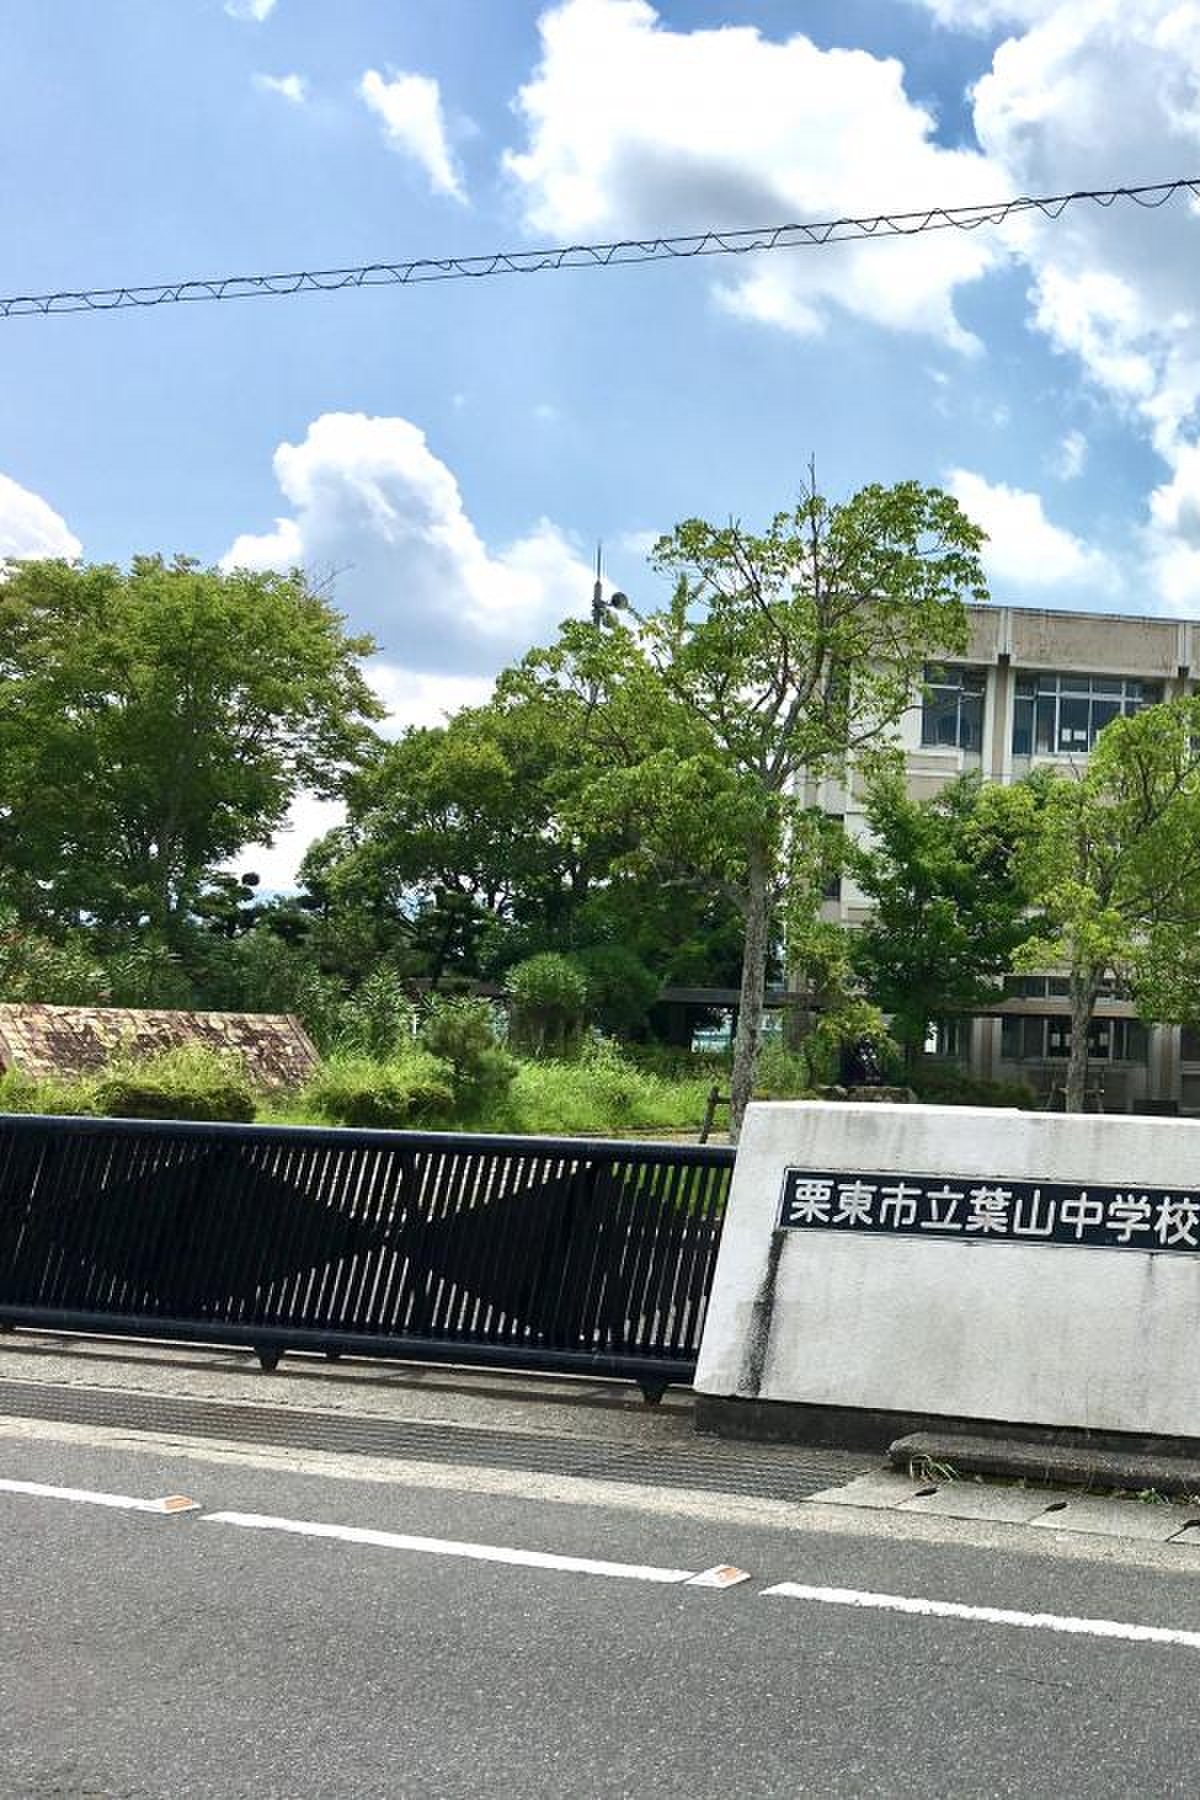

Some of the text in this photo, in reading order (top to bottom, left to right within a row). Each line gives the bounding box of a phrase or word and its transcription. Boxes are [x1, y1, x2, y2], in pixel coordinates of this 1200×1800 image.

[790, 1178, 1200, 1247] 栗東市立葉山中学校
